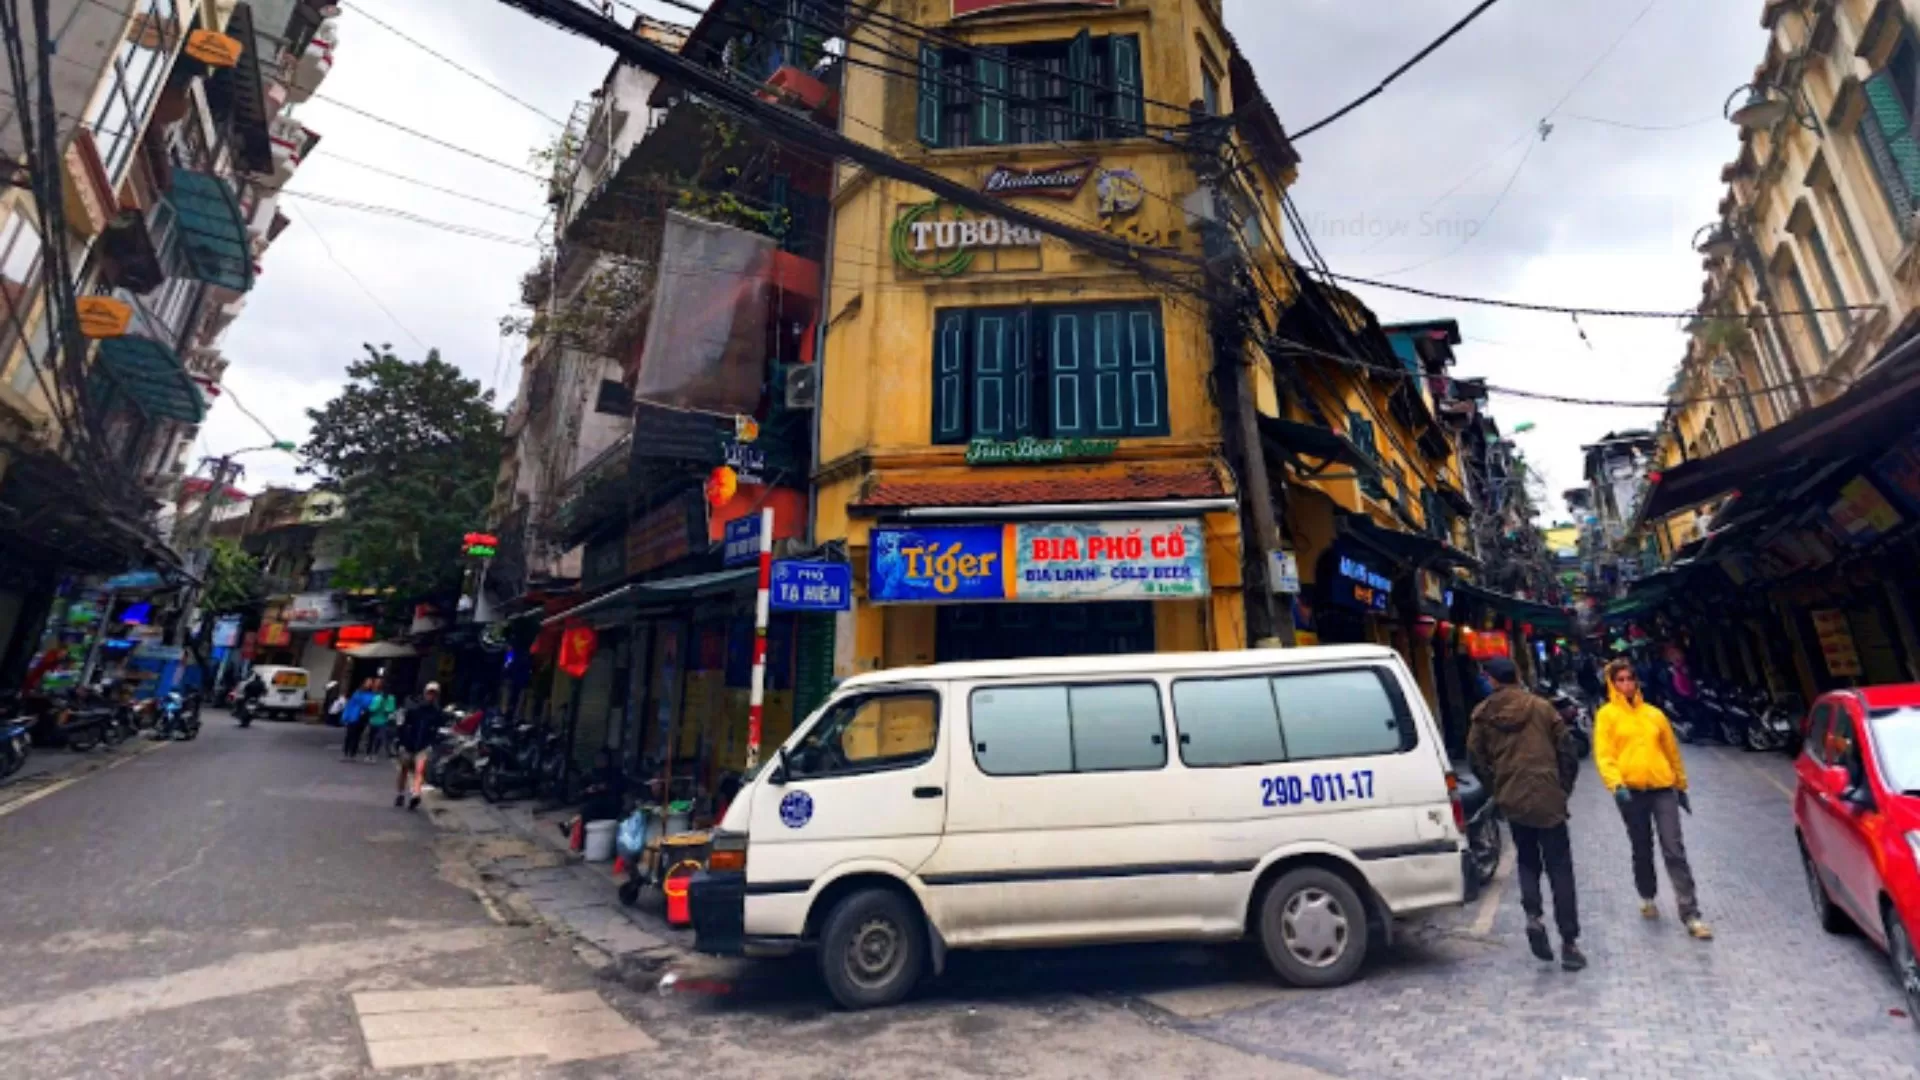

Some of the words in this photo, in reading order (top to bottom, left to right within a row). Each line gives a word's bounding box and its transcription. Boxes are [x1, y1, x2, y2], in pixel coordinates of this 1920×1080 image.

[987, 166, 1081, 191] Budweiser
[1032, 537, 1080, 561] BIA
[1087, 527, 1144, 561] PHỐ
[1151, 523, 1186, 559] CỔ
[901, 542, 997, 593] Tiger
[1261, 769, 1374, 807] 29D-011-17
